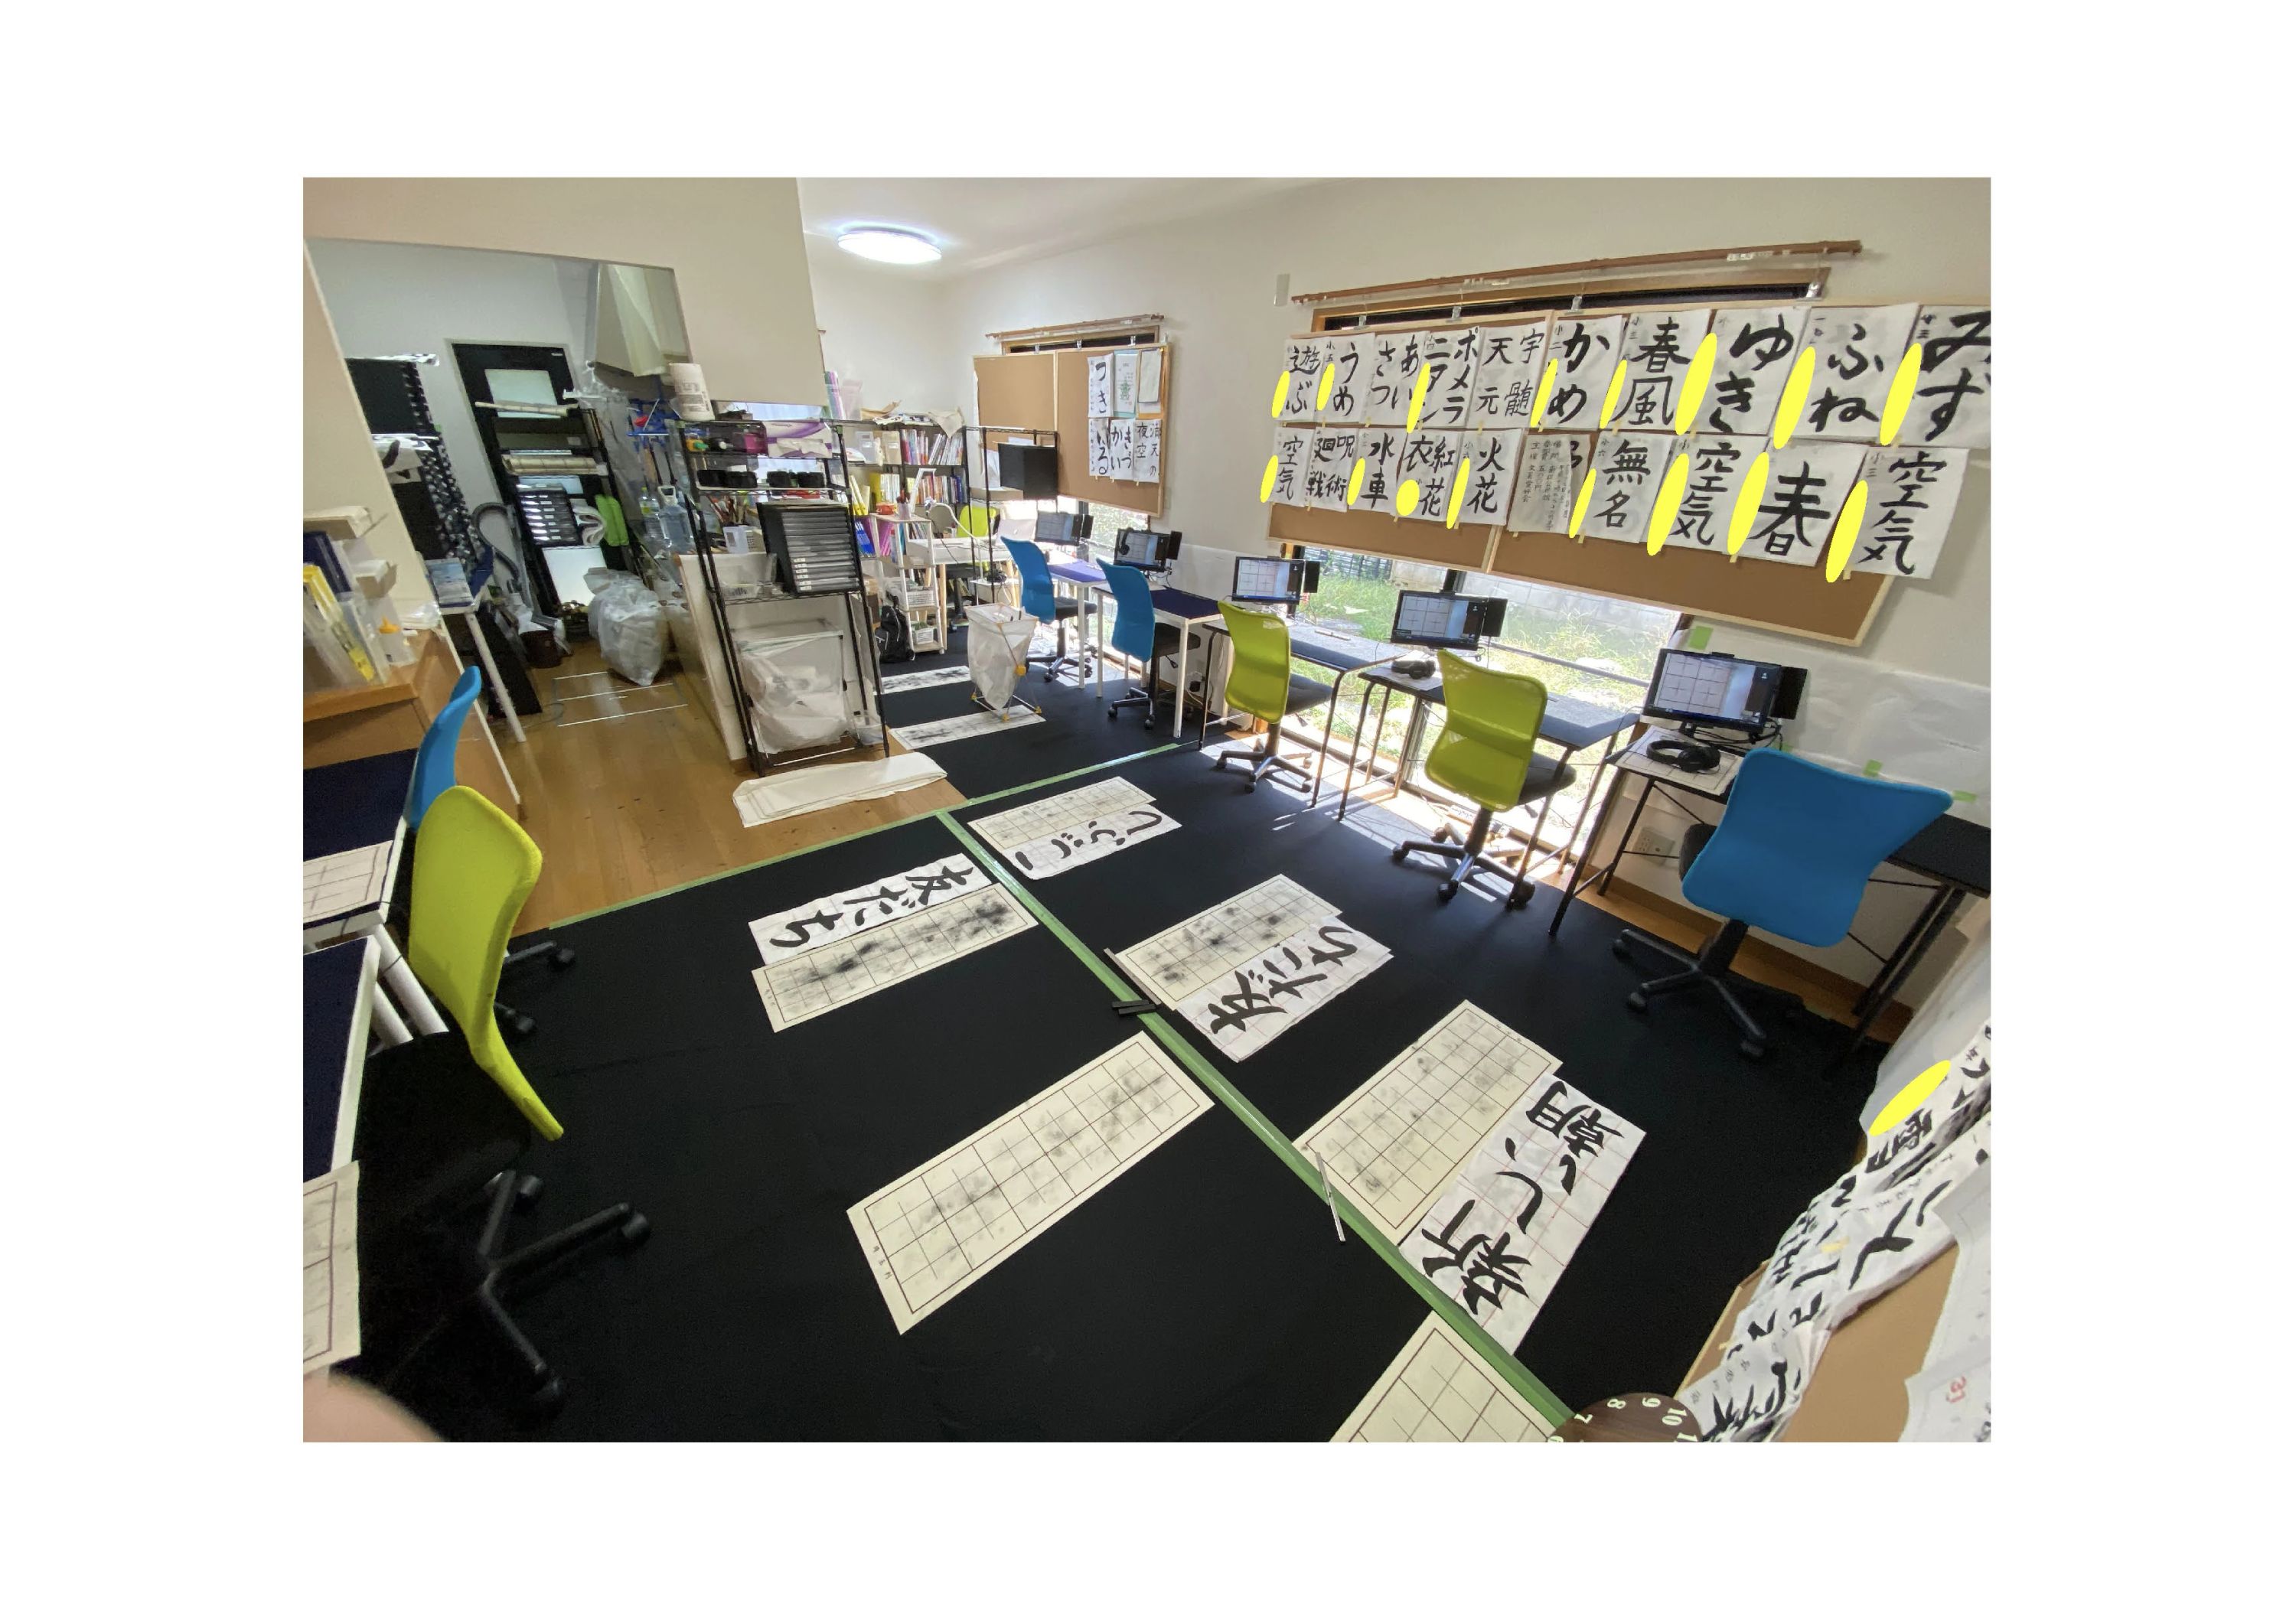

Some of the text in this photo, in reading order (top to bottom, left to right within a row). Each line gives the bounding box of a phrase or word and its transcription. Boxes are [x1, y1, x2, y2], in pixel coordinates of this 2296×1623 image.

[1095, 361, 1107, 413] つき
[1286, 345, 1321, 414] 遊ぶ
[1333, 341, 1358, 417] うめ
[1547, 322, 1610, 424] かめ
[1610, 316, 1691, 425] 春風
[1709, 313, 1794, 433] ゆき
[1808, 323, 1884, 432] ふね
[1137, 422, 1148, 458] 夜空
[1276, 435, 1303, 500] 空気
[1306, 438, 1336, 499] 廻戦
[1326, 435, 1355, 502] 呪術
[1361, 432, 1395, 509] 水車
[1466, 437, 1505, 513] 火花
[1593, 438, 1651, 528] 無名
[1668, 442, 1741, 546] 空気
[1746, 461, 1831, 556] 春
[1858, 451, 1947, 575] 空気
[770, 866, 974, 947] 友だち
[1208, 926, 1358, 1034] 友だち
[1421, 1080, 1623, 1315] 新しい朝
[1607, 1399, 1626, 1410] 8
[1642, 1397, 1661, 1408] 9
[1662, 1408, 1687, 1426] 10
